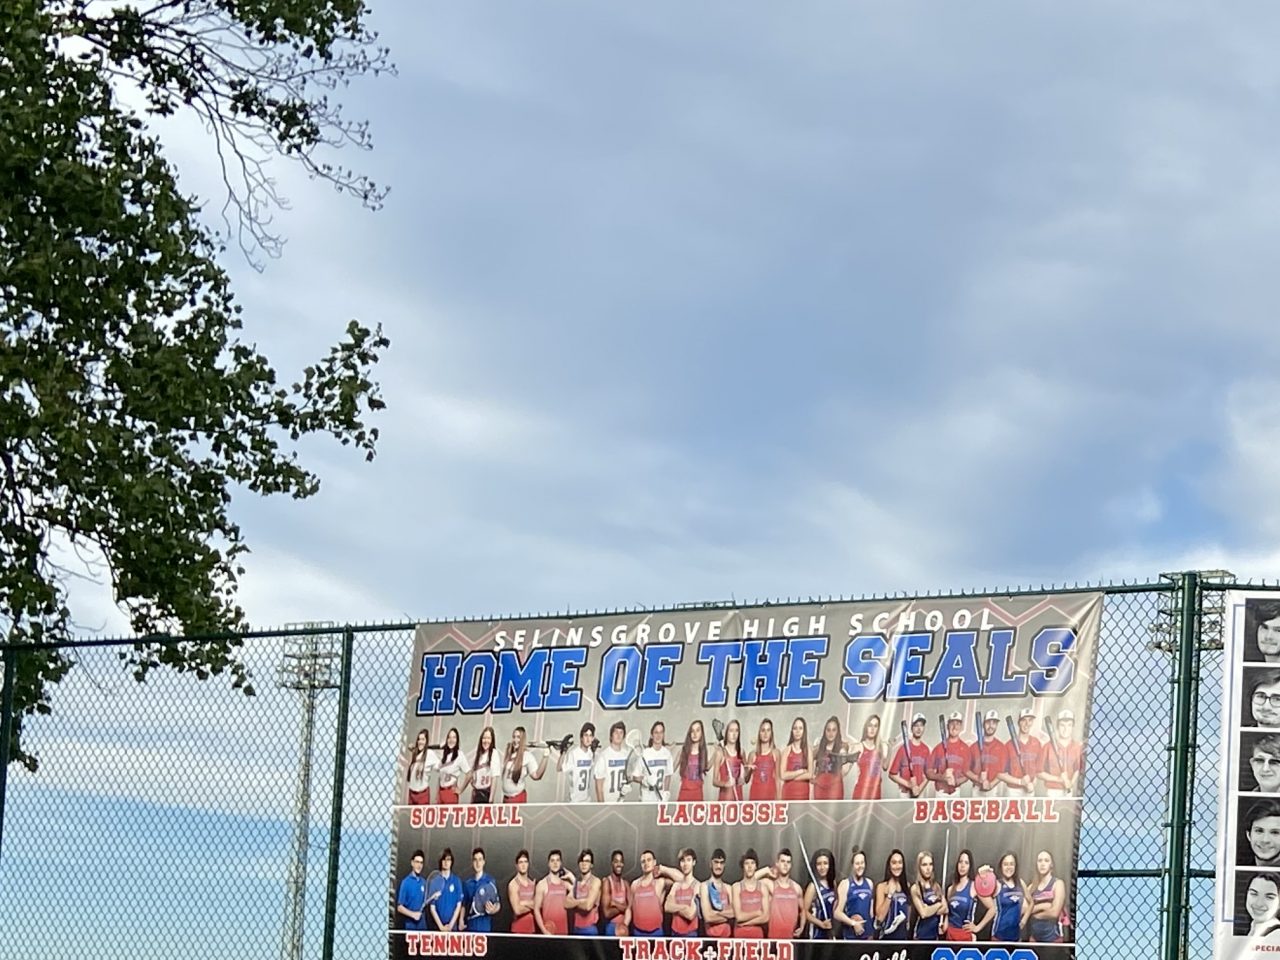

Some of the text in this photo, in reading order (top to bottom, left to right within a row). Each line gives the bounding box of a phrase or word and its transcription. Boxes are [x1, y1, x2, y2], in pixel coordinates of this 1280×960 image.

[494, 608, 994, 652] SELINSGROVE HIGH SCHOOL
[416, 626, 1078, 716] HOME OF THE SEALS
[410, 805, 523, 828] SOFTBALL
[657, 802, 789, 826] LACROSSE
[913, 799, 1059, 824] BASEBALL
[406, 934, 488, 957] TENNIS
